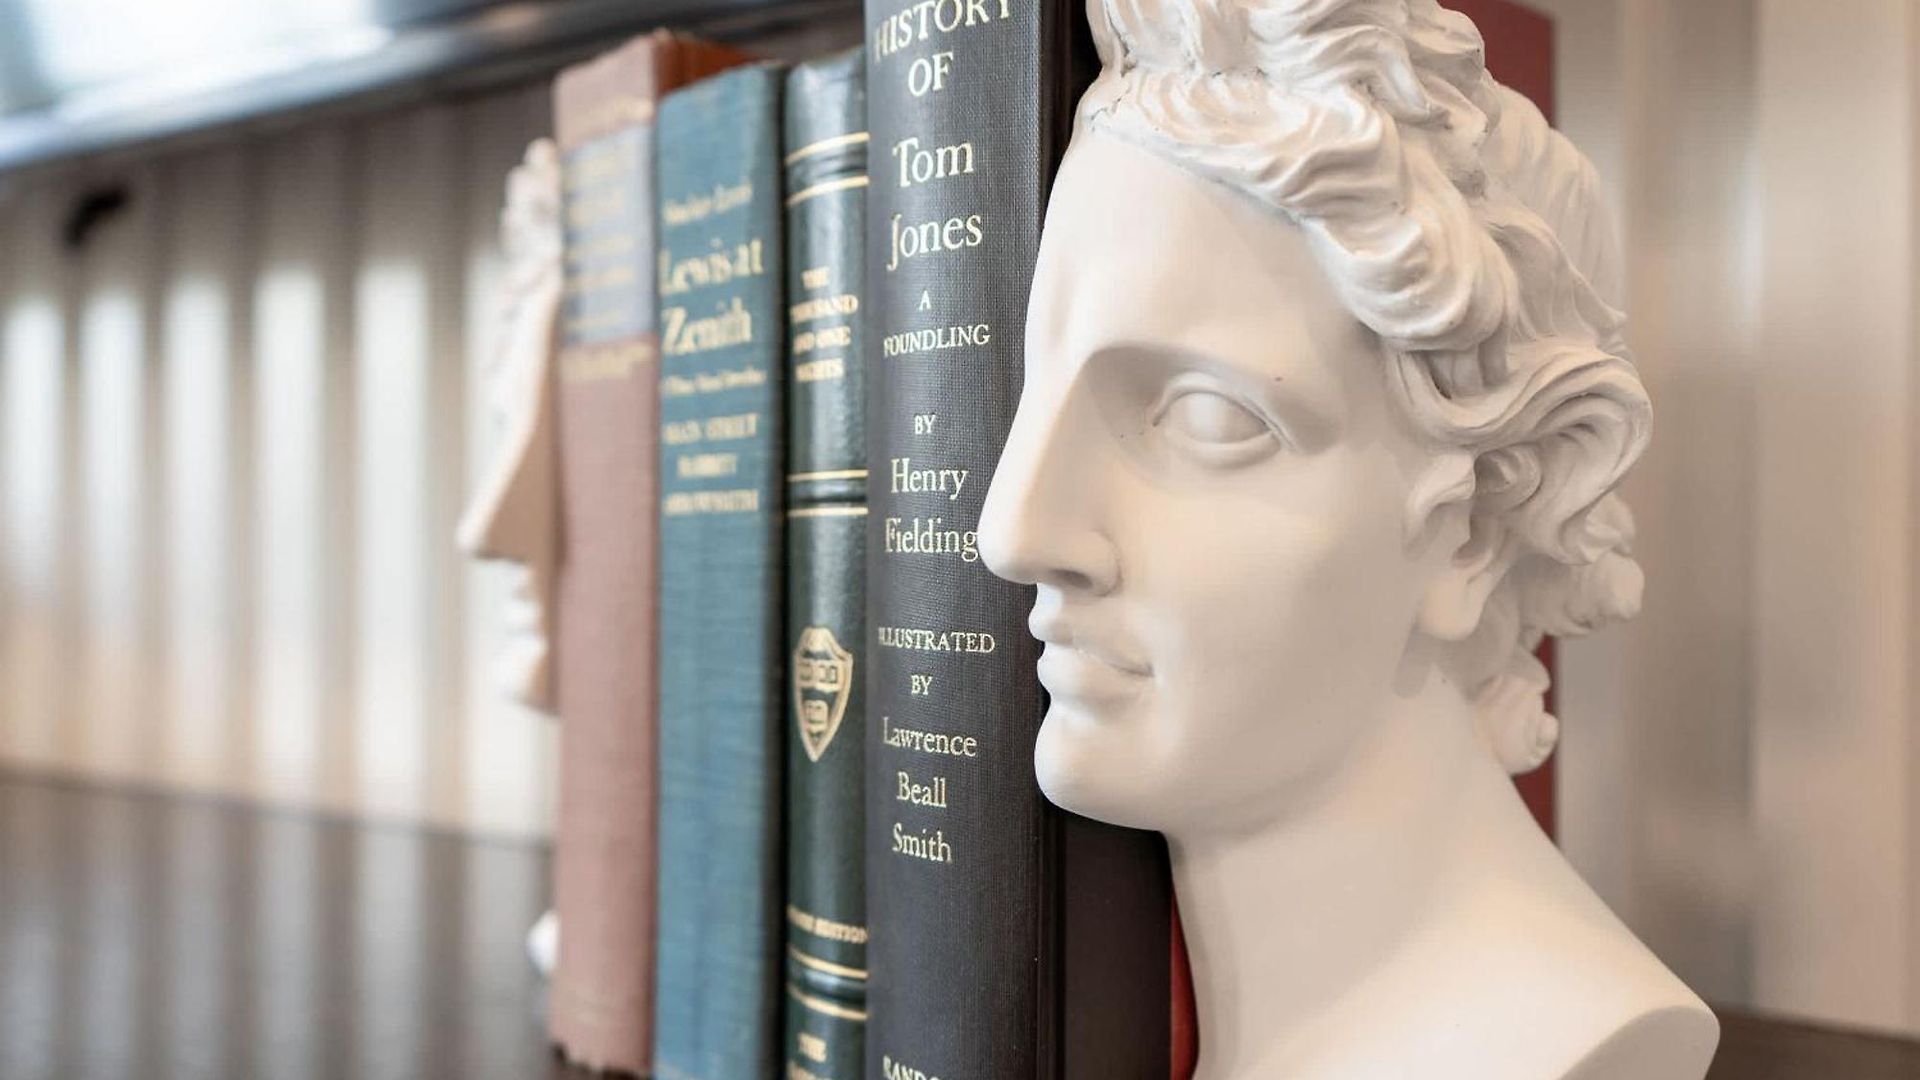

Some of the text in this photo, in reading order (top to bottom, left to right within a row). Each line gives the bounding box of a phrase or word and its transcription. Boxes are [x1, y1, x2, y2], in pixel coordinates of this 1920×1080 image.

[908, 52, 953, 97] OF
[892, 137, 974, 188] Tom
[886, 213, 983, 271] Jones
[918, 289, 931, 311] A
[883, 324, 991, 358] FOUNDLING
[914, 414, 936, 435] BY
[891, 457, 969, 501] Henry
[884, 517, 979, 563] Fielding
[877, 626, 996, 654] ILLUSTRATED
[911, 674, 933, 696] BY
[882, 716, 978, 757] Lawrence
[896, 771, 947, 808] Beall
[892, 822, 953, 864] Smith
